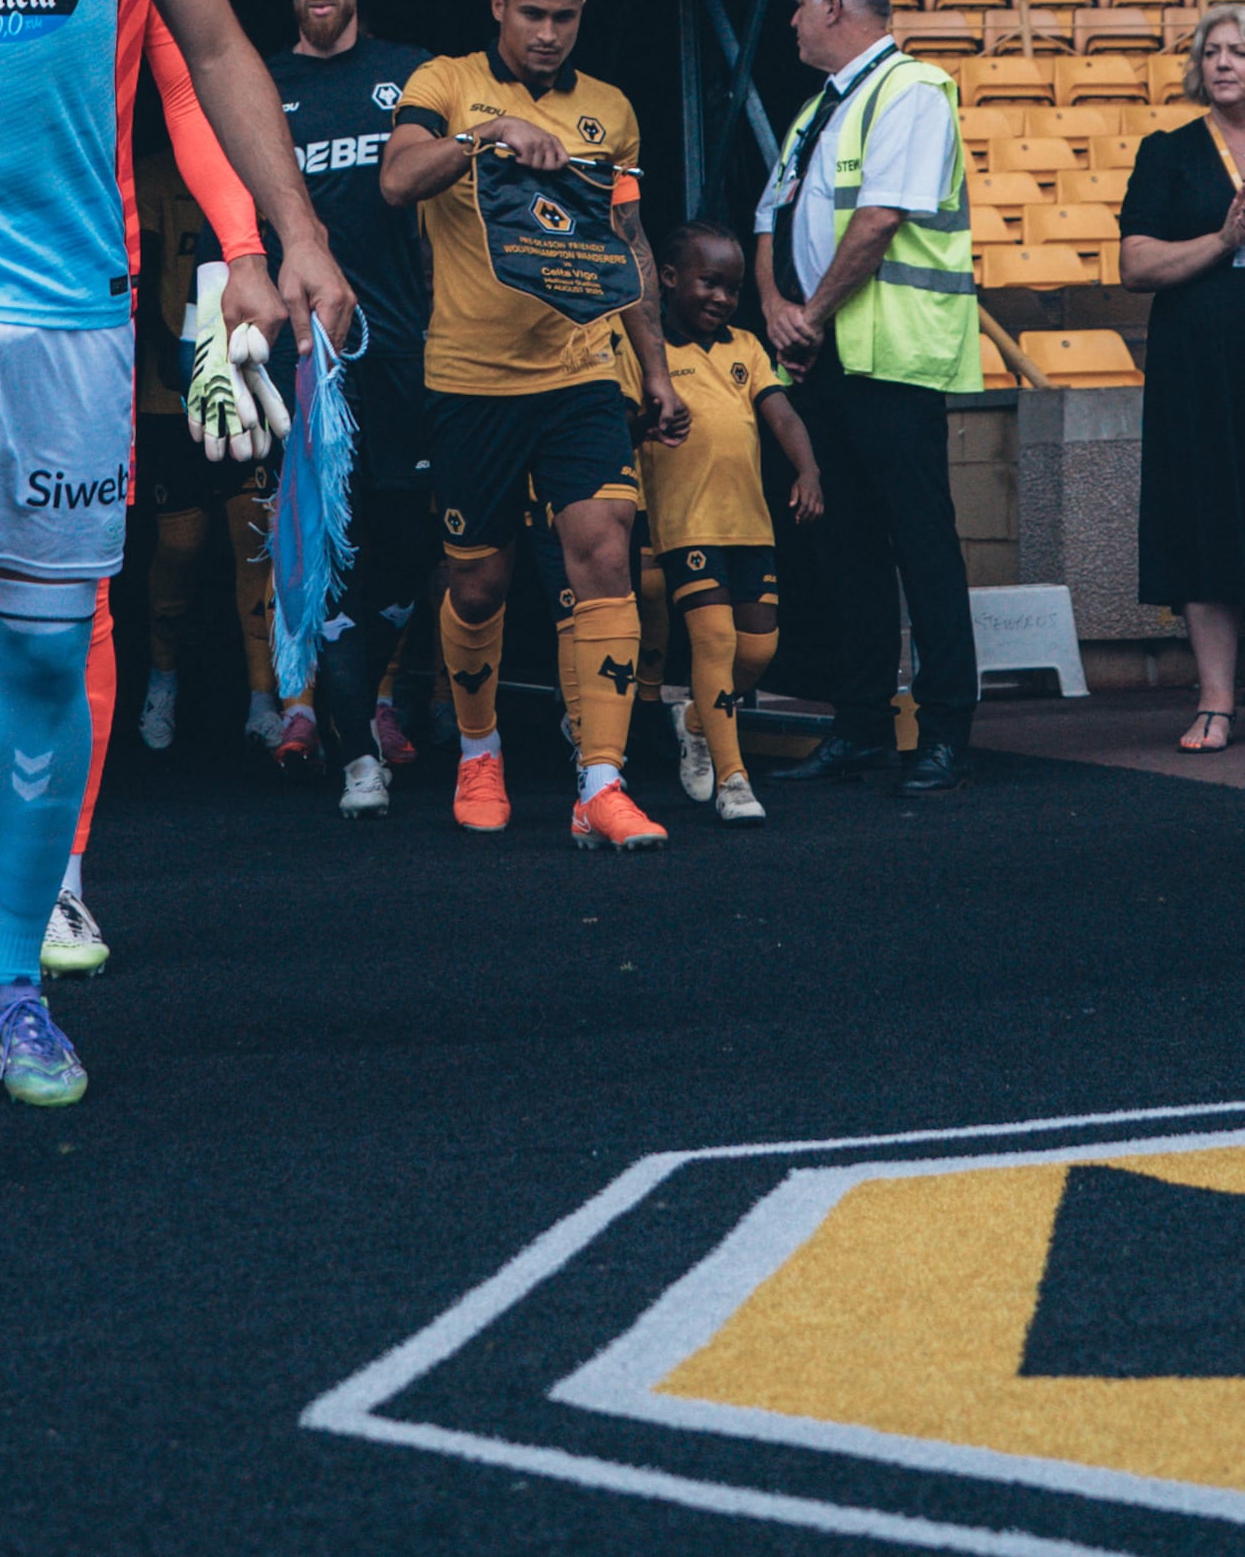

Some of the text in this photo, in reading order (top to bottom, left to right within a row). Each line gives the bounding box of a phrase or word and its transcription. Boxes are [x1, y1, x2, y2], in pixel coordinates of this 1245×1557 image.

[503, 244, 627, 265] WOLVERHAMPTON WANDERERS
[541, 267, 598, 281] Celta Vigo
